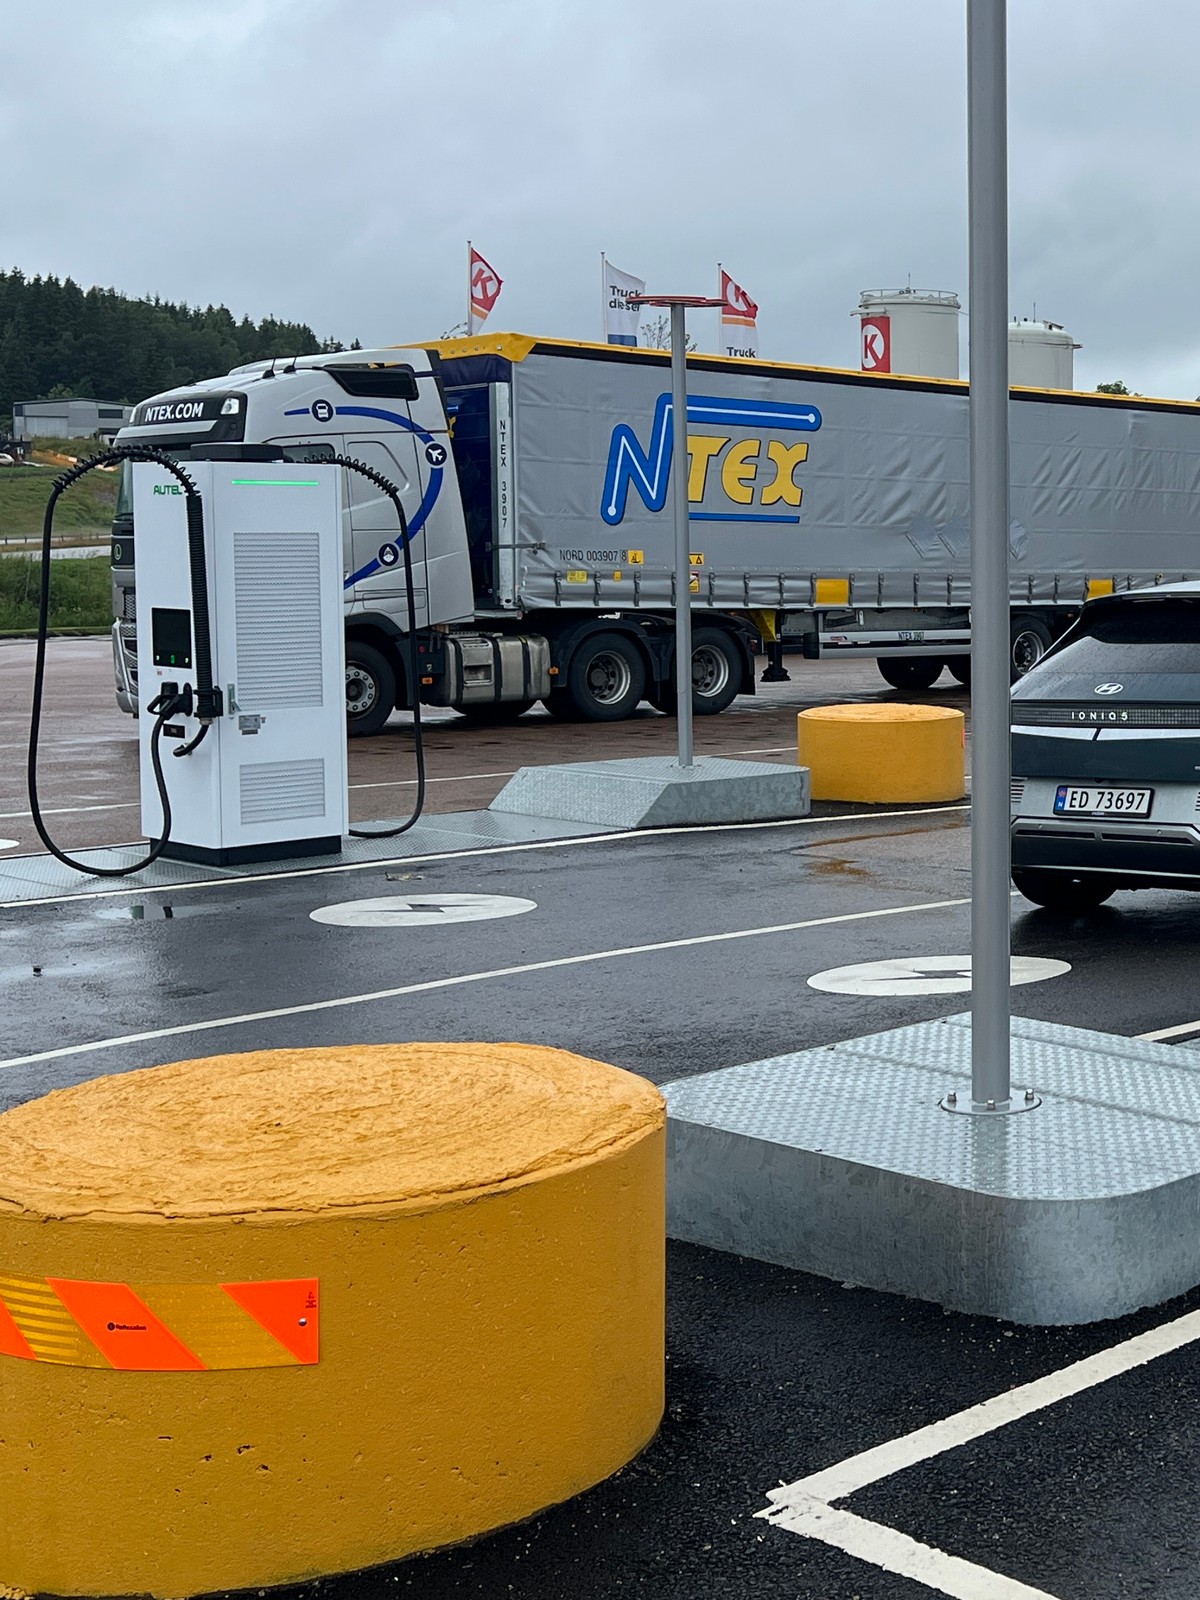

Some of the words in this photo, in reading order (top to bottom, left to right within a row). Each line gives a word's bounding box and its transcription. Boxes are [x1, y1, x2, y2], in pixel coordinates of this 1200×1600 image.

[609, 285, 642, 298] Truck
[726, 347, 756, 358] Truck
[864, 333, 880, 364] K
[144, 402, 204, 422] NTEX.COM
[601, 393, 821, 526] NTEX
[153, 485, 183, 496] AUTEL
[559, 550, 584, 561] NORD
[586, 550, 619, 562] 003907
[897, 631, 912, 640] NTEX
[1068, 790, 1089, 809] ED
[1096, 790, 1146, 811] 73697
